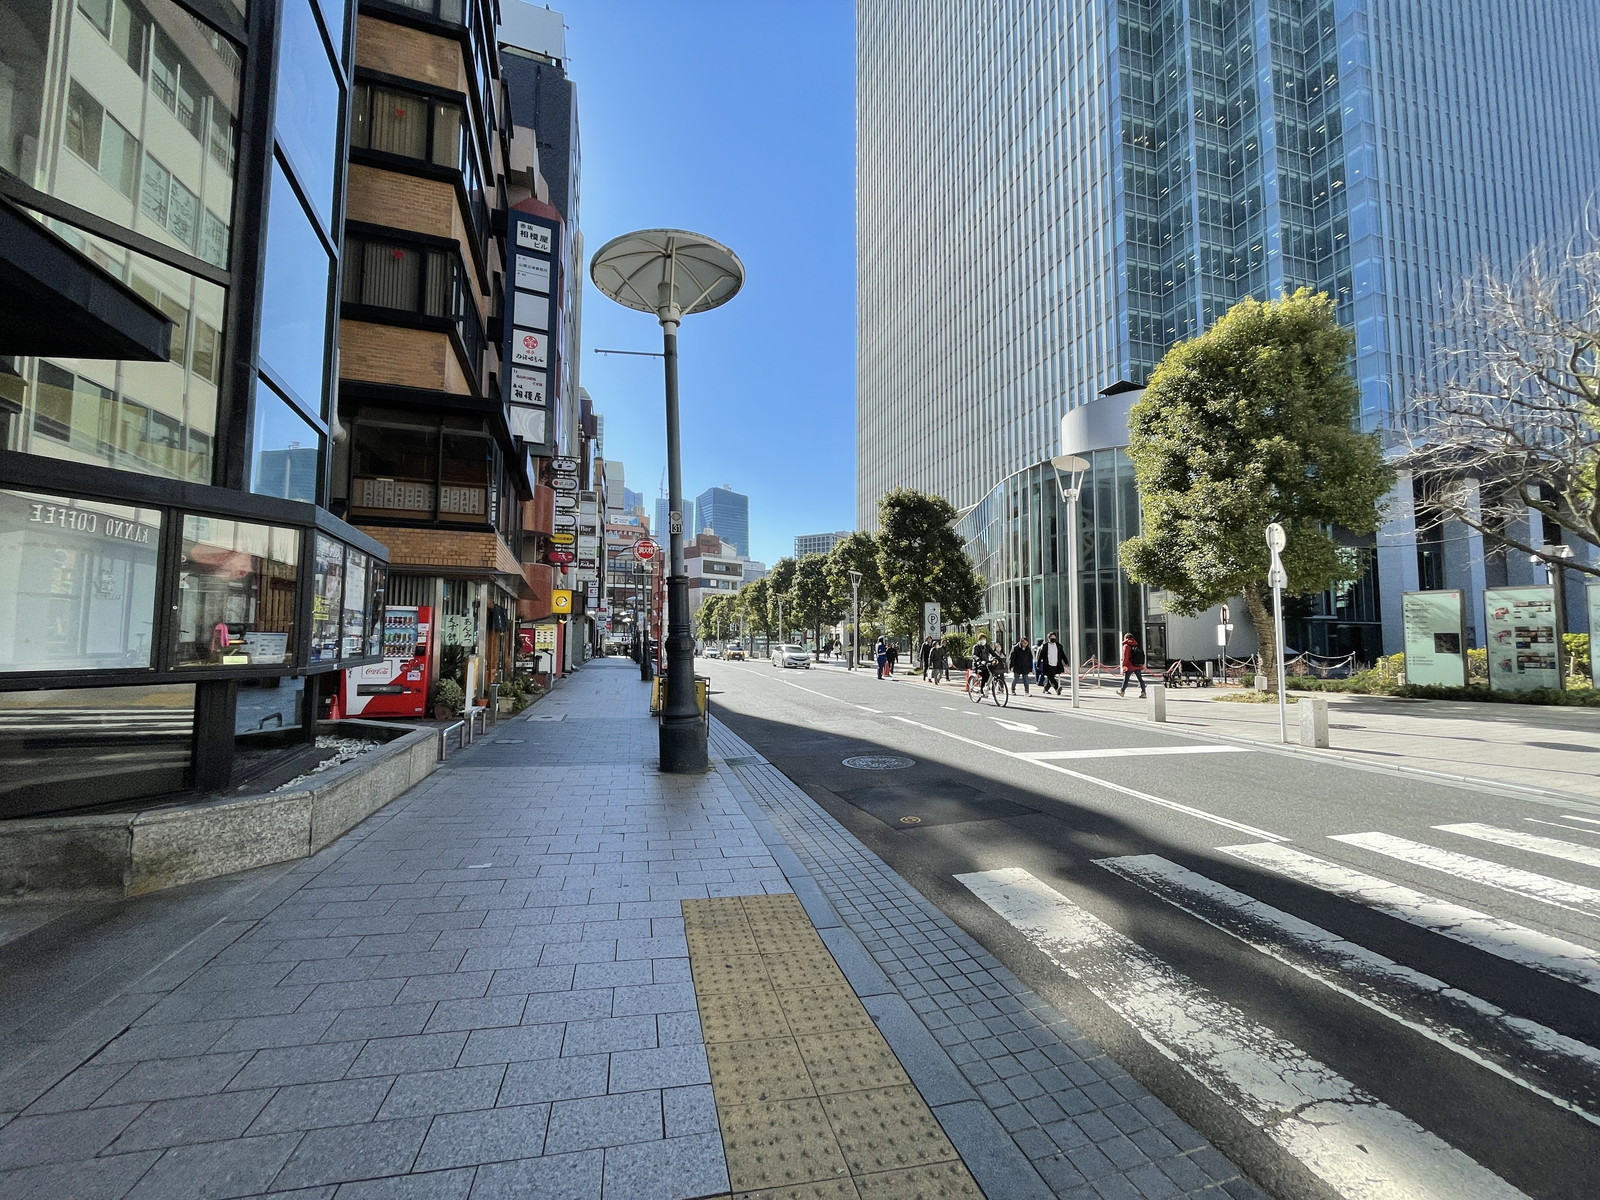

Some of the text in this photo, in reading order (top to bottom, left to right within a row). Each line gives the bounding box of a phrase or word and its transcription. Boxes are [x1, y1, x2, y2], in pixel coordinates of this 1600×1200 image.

[520, 230, 548, 243] 相模屋
[534, 242, 548, 250] ビル
[515, 390, 542, 402] 相模屋
[673, 524, 681, 532] 31
[462, 618, 472, 643] あんみつ
